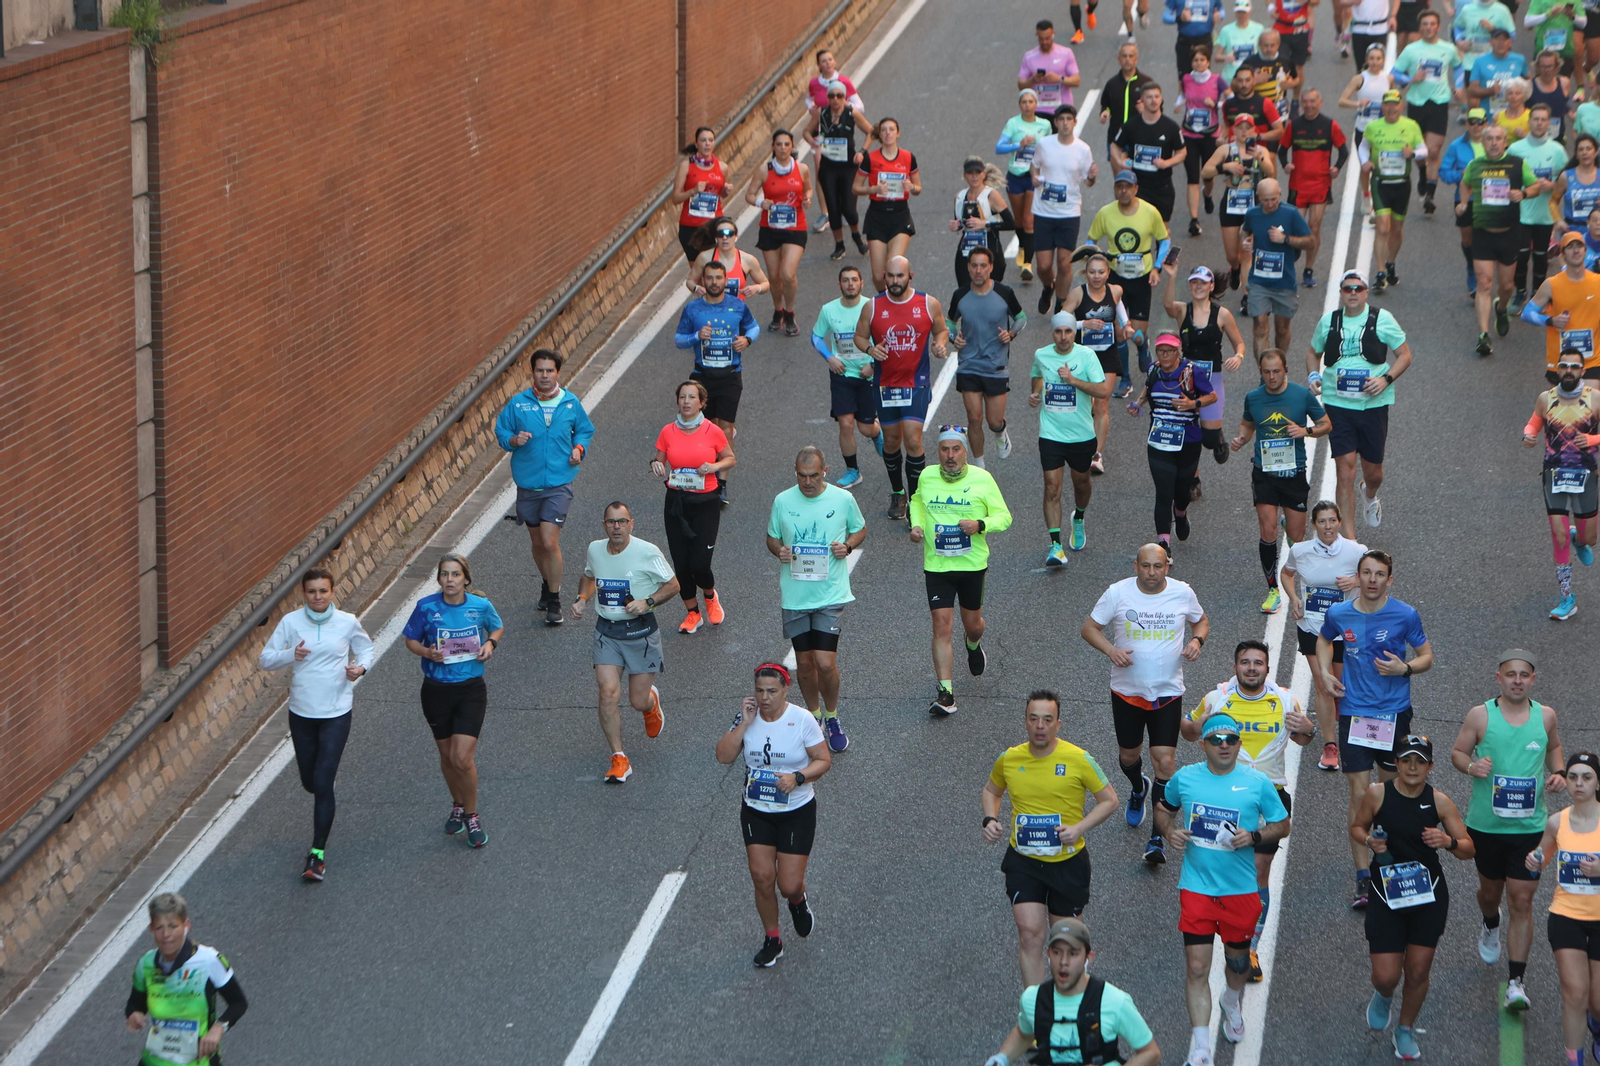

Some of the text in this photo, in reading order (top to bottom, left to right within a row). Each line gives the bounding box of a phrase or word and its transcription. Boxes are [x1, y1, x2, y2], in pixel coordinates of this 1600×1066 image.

[1138, 611, 1154, 619] When
[1154, 611, 1165, 620] life
[451, 630, 474, 638] ZURICH
[1124, 620, 1177, 641] TENNIS
[1236, 721, 1280, 733] DIGI
[1366, 723, 1380, 731] 7560
[1508, 779, 1533, 787] ZURICH
[759, 785, 777, 794] 12753
[759, 794, 775, 802] MARIA
[1207, 808, 1234, 818] ZURICH
[1203, 822, 1220, 831] 1309
[1028, 831, 1048, 839] 11900
[1397, 878, 1417, 889] 11341
[1573, 877, 1592, 885] LAURA
